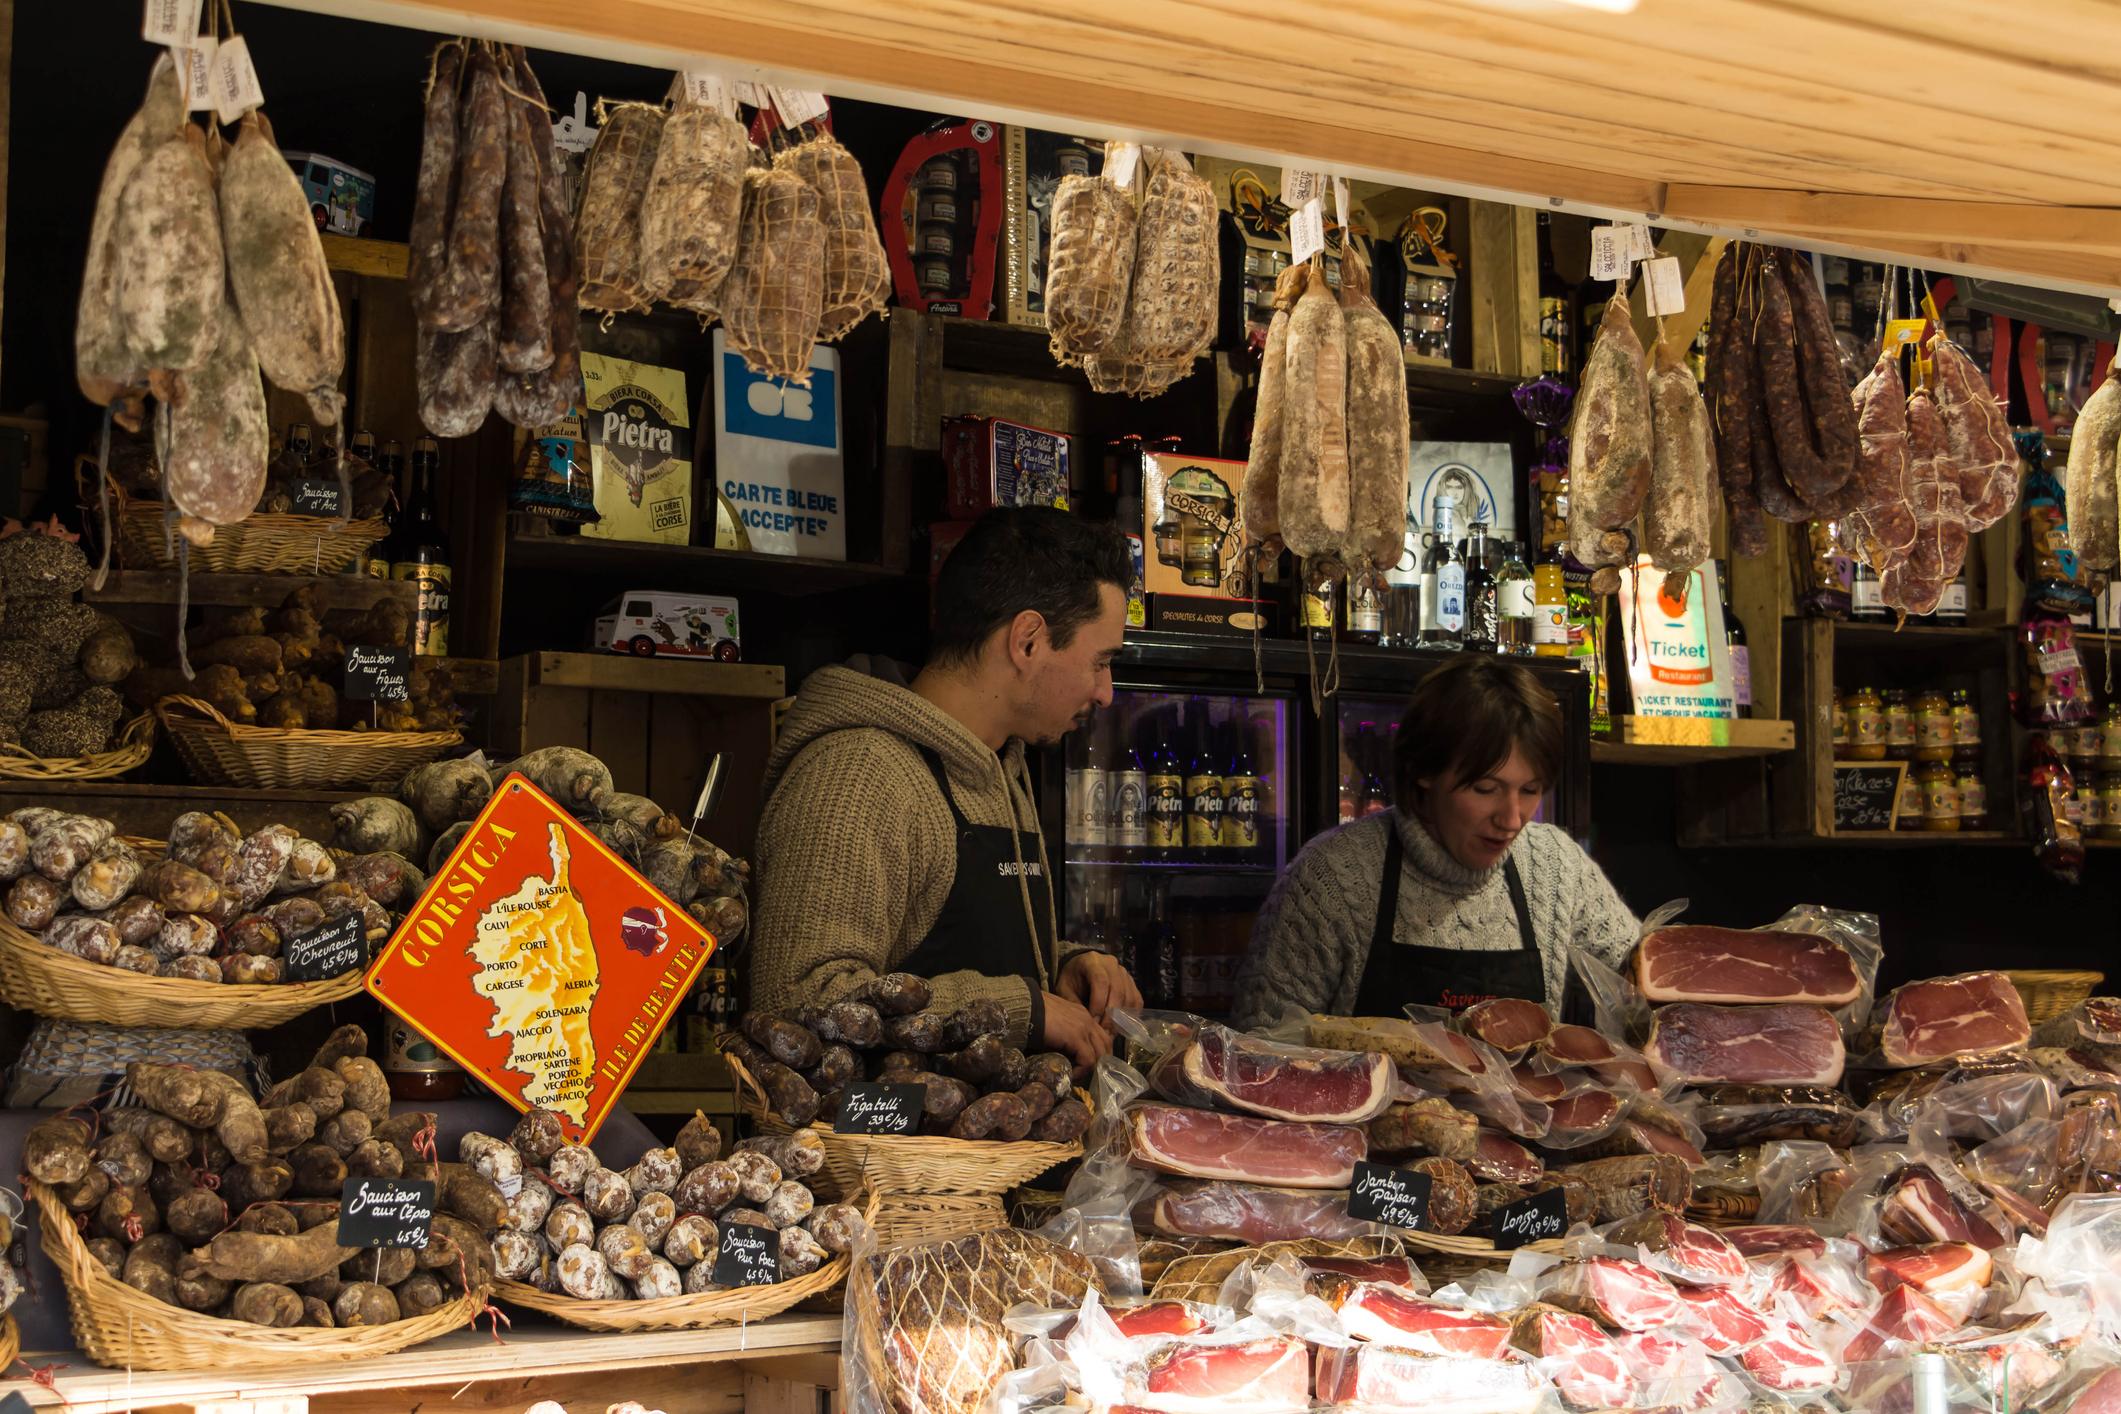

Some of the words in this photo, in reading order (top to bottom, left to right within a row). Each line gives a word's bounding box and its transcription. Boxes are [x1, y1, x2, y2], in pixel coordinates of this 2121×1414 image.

[1013, 143, 1022, 188] MEILLEUR
[1013, 191, 1022, 208] DES
[1013, 274, 1022, 309] CORSES
[610, 387, 634, 402] BIERA
[635, 387, 663, 413] CORSA
[601, 411, 674, 454] Pietra
[297, 482, 338, 502] Saucisson
[725, 480, 783, 506] CARTE
[786, 489, 838, 515] BLEUE
[526, 505, 580, 519] CANISTRELLI
[654, 504, 664, 513] LA
[663, 500, 682, 511] BIÈRE
[1170, 493, 1222, 527] CORSICA
[656, 513, 684, 528] CORSE
[418, 591, 449, 610] etra
[1162, 611, 1196, 623] SPECIALITES
[1204, 614, 1224, 624] CORSE
[1650, 641, 1706, 658] Ticket
[347, 647, 395, 671] Saucisson
[363, 665, 378, 674] aux
[1658, 670, 1706, 681] Restaurant
[375, 668, 404, 692] Figues
[1674, 696, 1733, 708] RESTAURANT
[401, 819, 518, 969] CORSICA
[538, 885, 569, 896] BASTIA
[496, 902, 517, 914] L'ÎLE
[517, 900, 552, 912] ROUSSE
[484, 920, 510, 932] CALVI
[289, 927, 340, 965] Saucisson
[345, 917, 359, 931] de
[301, 930, 358, 966] Chevreuil
[519, 940, 549, 951] CORTE
[486, 960, 518, 972] PORTO
[485, 979, 525, 992] CARGESE
[564, 979, 594, 991] ALERIA
[535, 1005, 588, 1020] SOLENZARA
[600, 1044, 632, 1082] ILE
[623, 1016, 650, 1047] DE
[641, 942, 698, 1020] BEAUTE
[515, 1025, 553, 1039] AJACCIO
[514, 1049, 567, 1063] PROPRIANO
[543, 1057, 581, 1070] SARTENE
[548, 1069, 582, 1081] PORTO-
[543, 1078, 584, 1091] VECCHIO
[535, 1090, 585, 1105] BONIFACIO
[846, 1092, 903, 1122] Figatelli
[1356, 1170, 1406, 1194] Jambon
[349, 1181, 421, 1215] Saucisson
[1369, 1188, 1417, 1208] Paysan
[371, 1205, 397, 1217] aux
[1501, 1207, 1539, 1234] Lonzo
[722, 1227, 766, 1254] Saucisson
[734, 1247, 753, 1265] Pur
[758, 1251, 776, 1268] Porc
